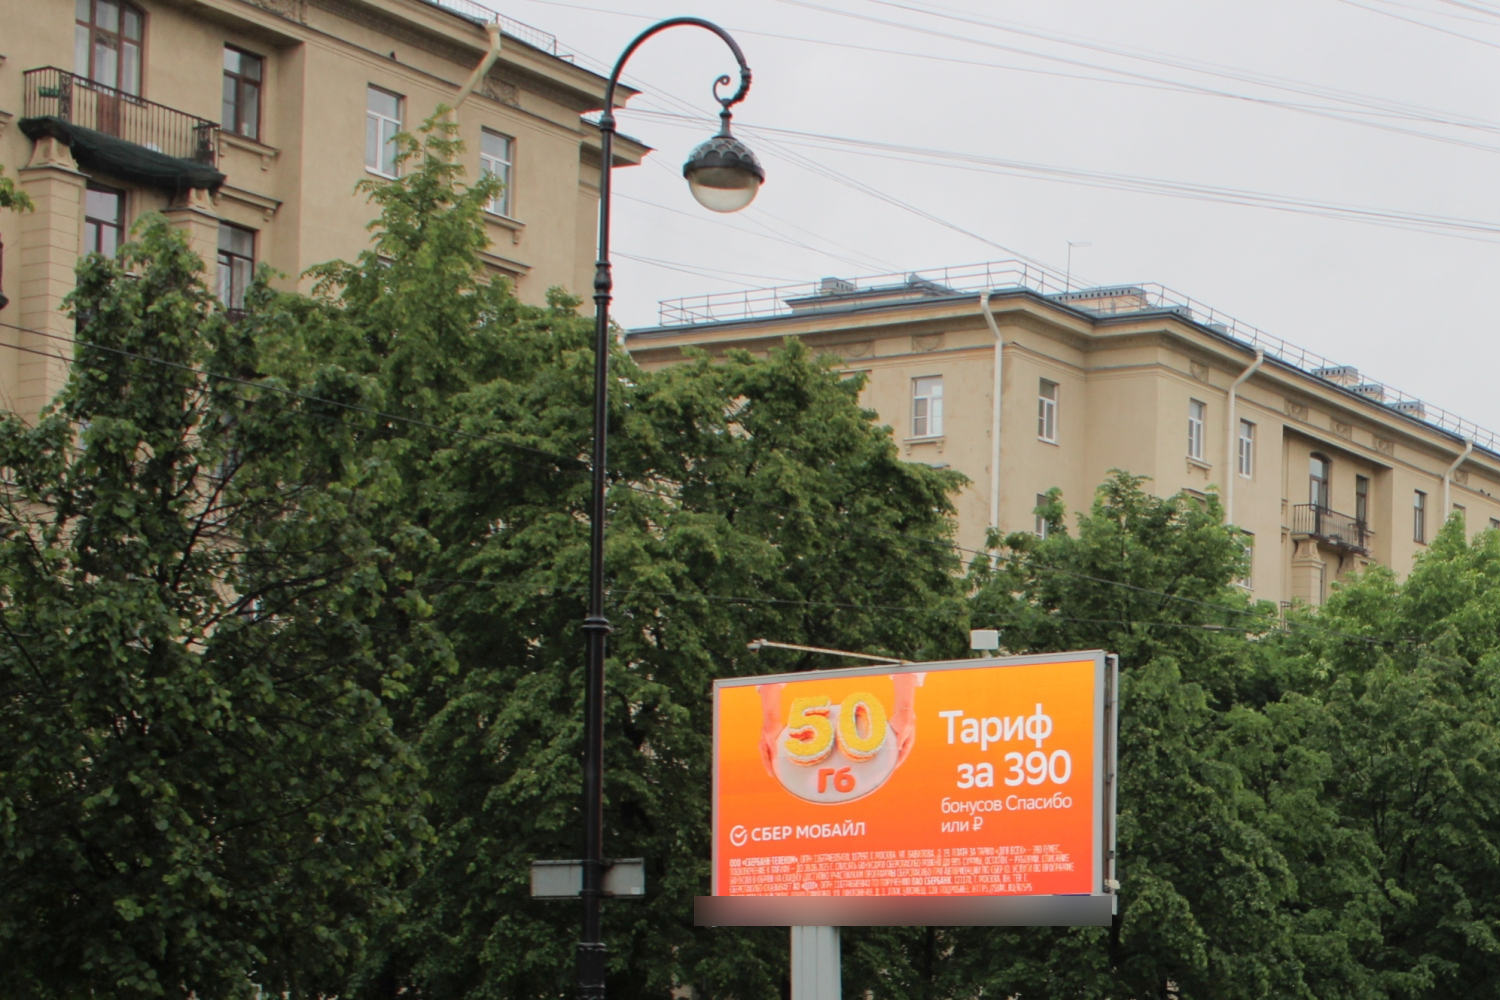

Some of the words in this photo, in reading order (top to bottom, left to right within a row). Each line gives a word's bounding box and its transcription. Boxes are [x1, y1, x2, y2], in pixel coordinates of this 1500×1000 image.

[785, 692, 887, 766] 50
[938, 702, 1052, 751] Тариф
[817, 766, 855, 794] Гб
[956, 762, 994, 788] за
[1003, 749, 1072, 786] 390
[941, 797, 1002, 816] бонусов
[1005, 792, 1073, 811] Спасибо
[752, 825, 792, 841] СБЕР
[795, 819, 866, 839] МОБАЙЛ
[941, 821, 969, 832] или
